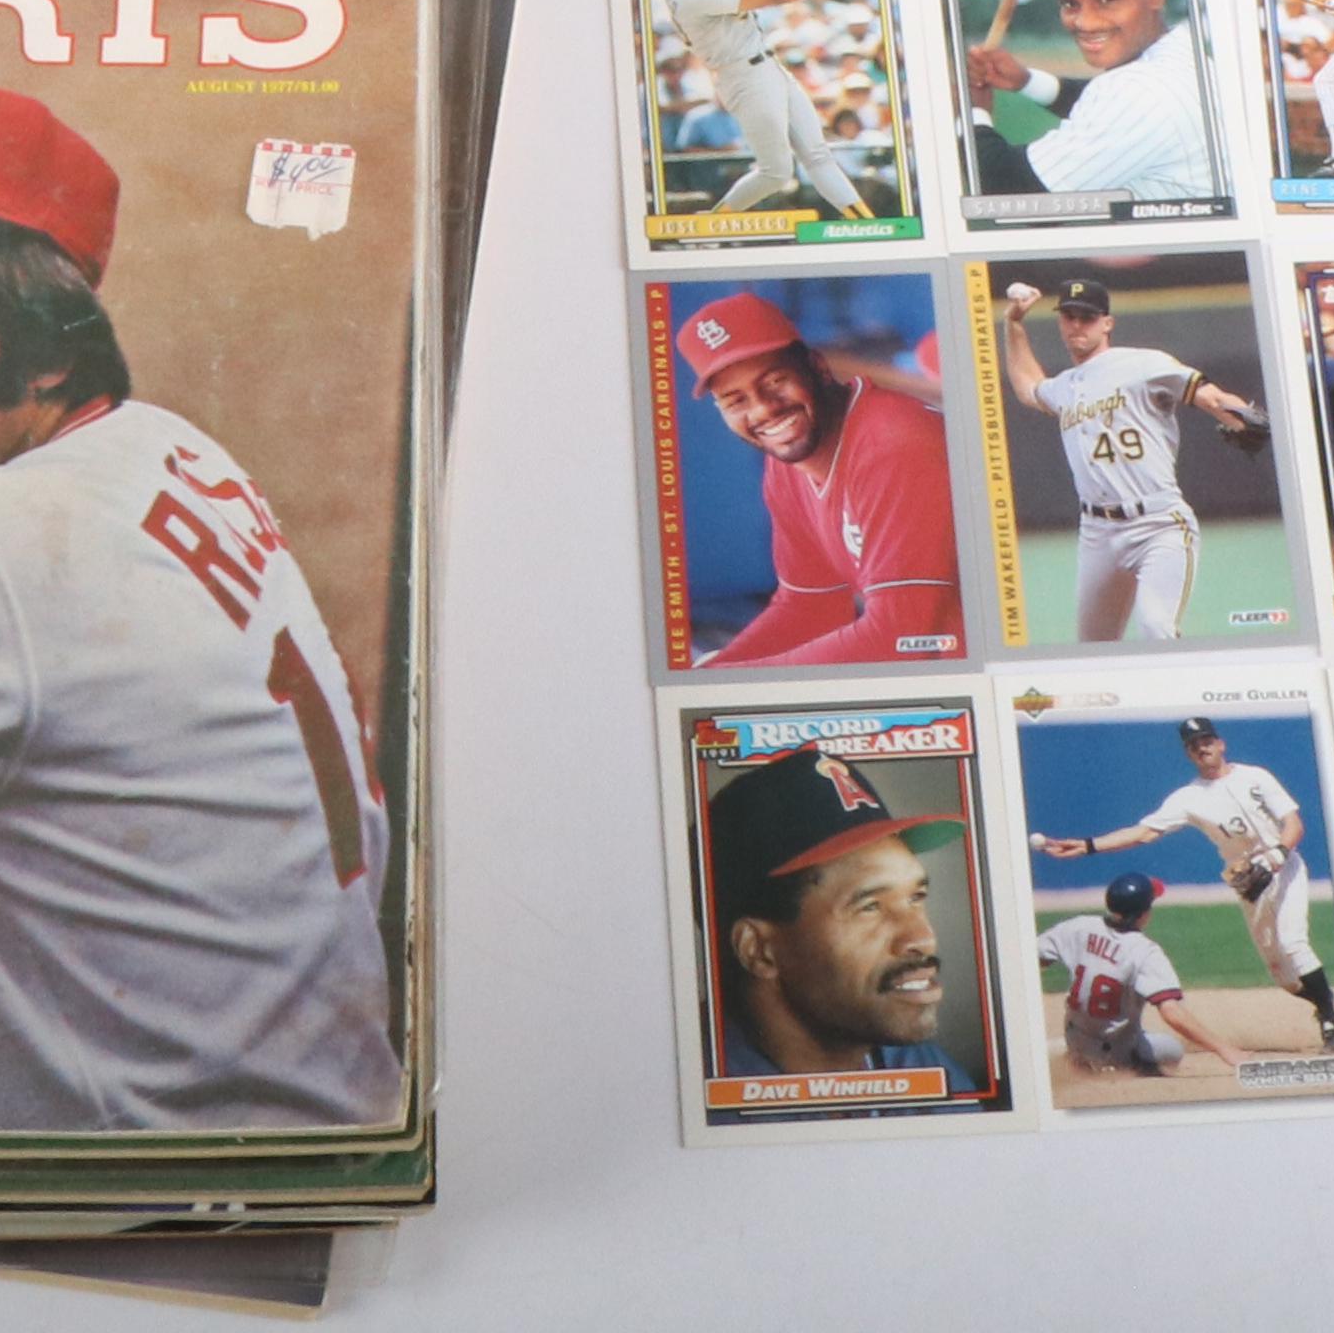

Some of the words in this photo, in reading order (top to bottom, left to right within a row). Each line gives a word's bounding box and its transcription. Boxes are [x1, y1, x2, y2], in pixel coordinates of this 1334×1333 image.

[186, 80, 255, 94] AUGUST
[973, 201, 1040, 214] SAMMY
[1052, 198, 1103, 212] SOSA
[1133, 204, 1179, 218] White
[823, 223, 895, 238] Athletics
[973, 293, 993, 364] PIRATES
[652, 319, 673, 430] CARDINALS
[980, 368, 1007, 481] PITTSBURGH
[1093, 429, 1144, 464] 49
[661, 438, 677, 497] LOUIS
[995, 498, 1018, 601] WAKEFIELD
[667, 556, 682, 619] SMITH
[1007, 607, 1020, 637] TIM
[671, 628, 686, 662] LEE
[1202, 691, 1242, 702] OZZIE
[1247, 688, 1308, 701] GUILLEN
[751, 718, 880, 748] RECORD
[816, 723, 961, 754] BREAKER
[700, 747, 739, 760] 1991
[1086, 933, 1119, 965] HILL
[1067, 964, 1124, 1020] 18
[743, 1081, 800, 1101] DAVE
[807, 1078, 911, 1098] WINFIELD
